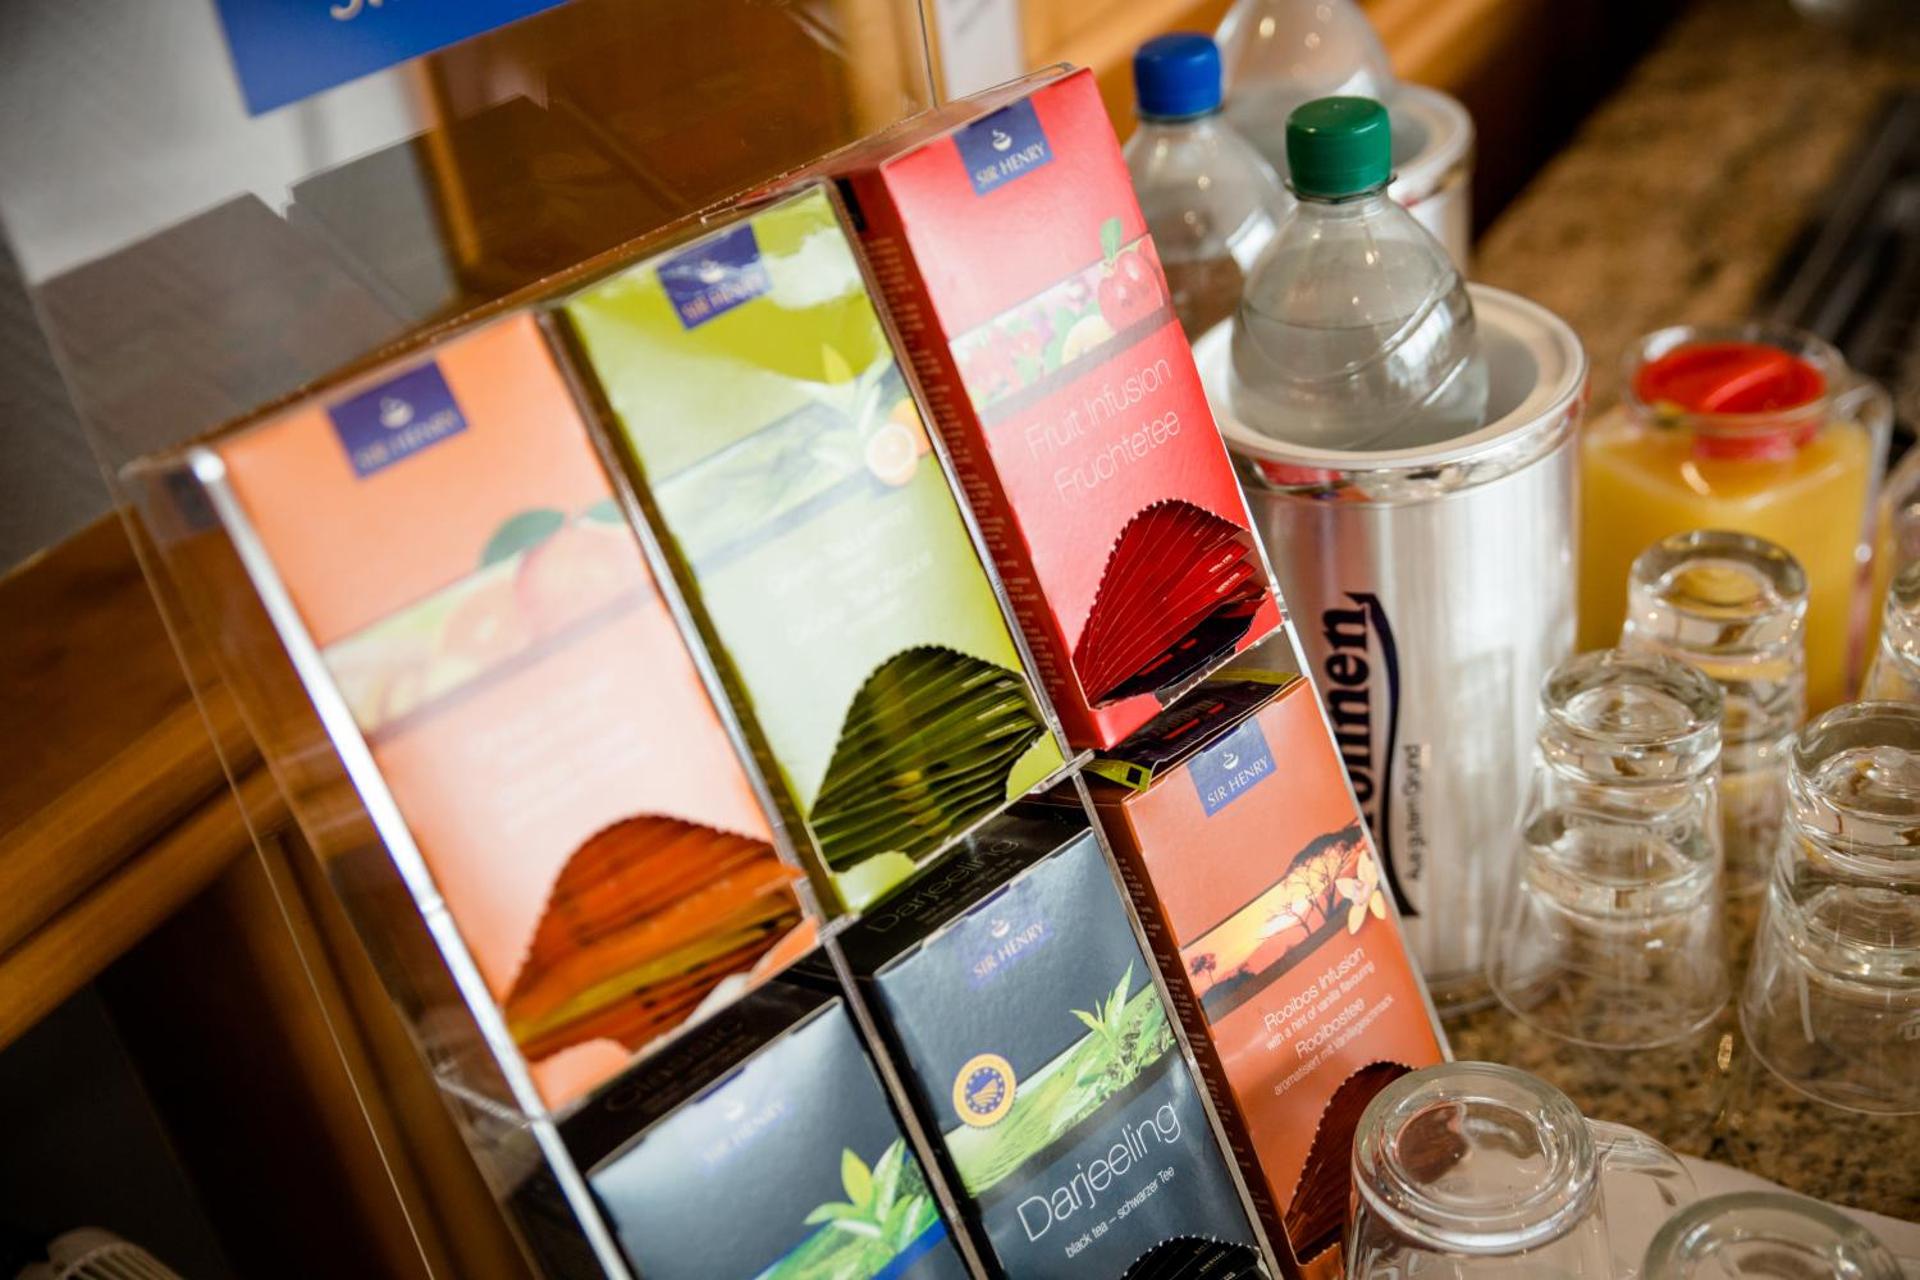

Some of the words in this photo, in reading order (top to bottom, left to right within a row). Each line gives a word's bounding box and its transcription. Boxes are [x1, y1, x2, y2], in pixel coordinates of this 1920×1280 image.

[976, 164, 999, 183] SIR
[999, 142, 1045, 175] HENRY
[681, 297, 711, 319] SIR
[1024, 409, 1086, 460] Fruit
[1085, 359, 1171, 426] Infusion
[1207, 786, 1228, 807] SIR
[1228, 755, 1268, 793] HENRY
[1401, 743, 1421, 797] Grund
[973, 956, 999, 979] SIR
[997, 920, 1045, 961] HENRY
[1264, 985, 1319, 1032] Rooibos
[1318, 948, 1365, 989] Infusion
[1266, 1034, 1285, 1051] with
[1284, 1029, 1292, 1038] a
[1292, 1015, 1309, 1032] hint
[1307, 1006, 1317, 1020] of
[1295, 998, 1365, 1059] Rooibostee
[1274, 1056, 1321, 1095] aromatisiert
[1017, 1101, 1182, 1243] Darjeeling
[1065, 1232, 1092, 1259] black
[1092, 1219, 1109, 1240] tea
[1117, 1179, 1160, 1220] schwarzer
[1158, 1165, 1176, 1184] Tee
